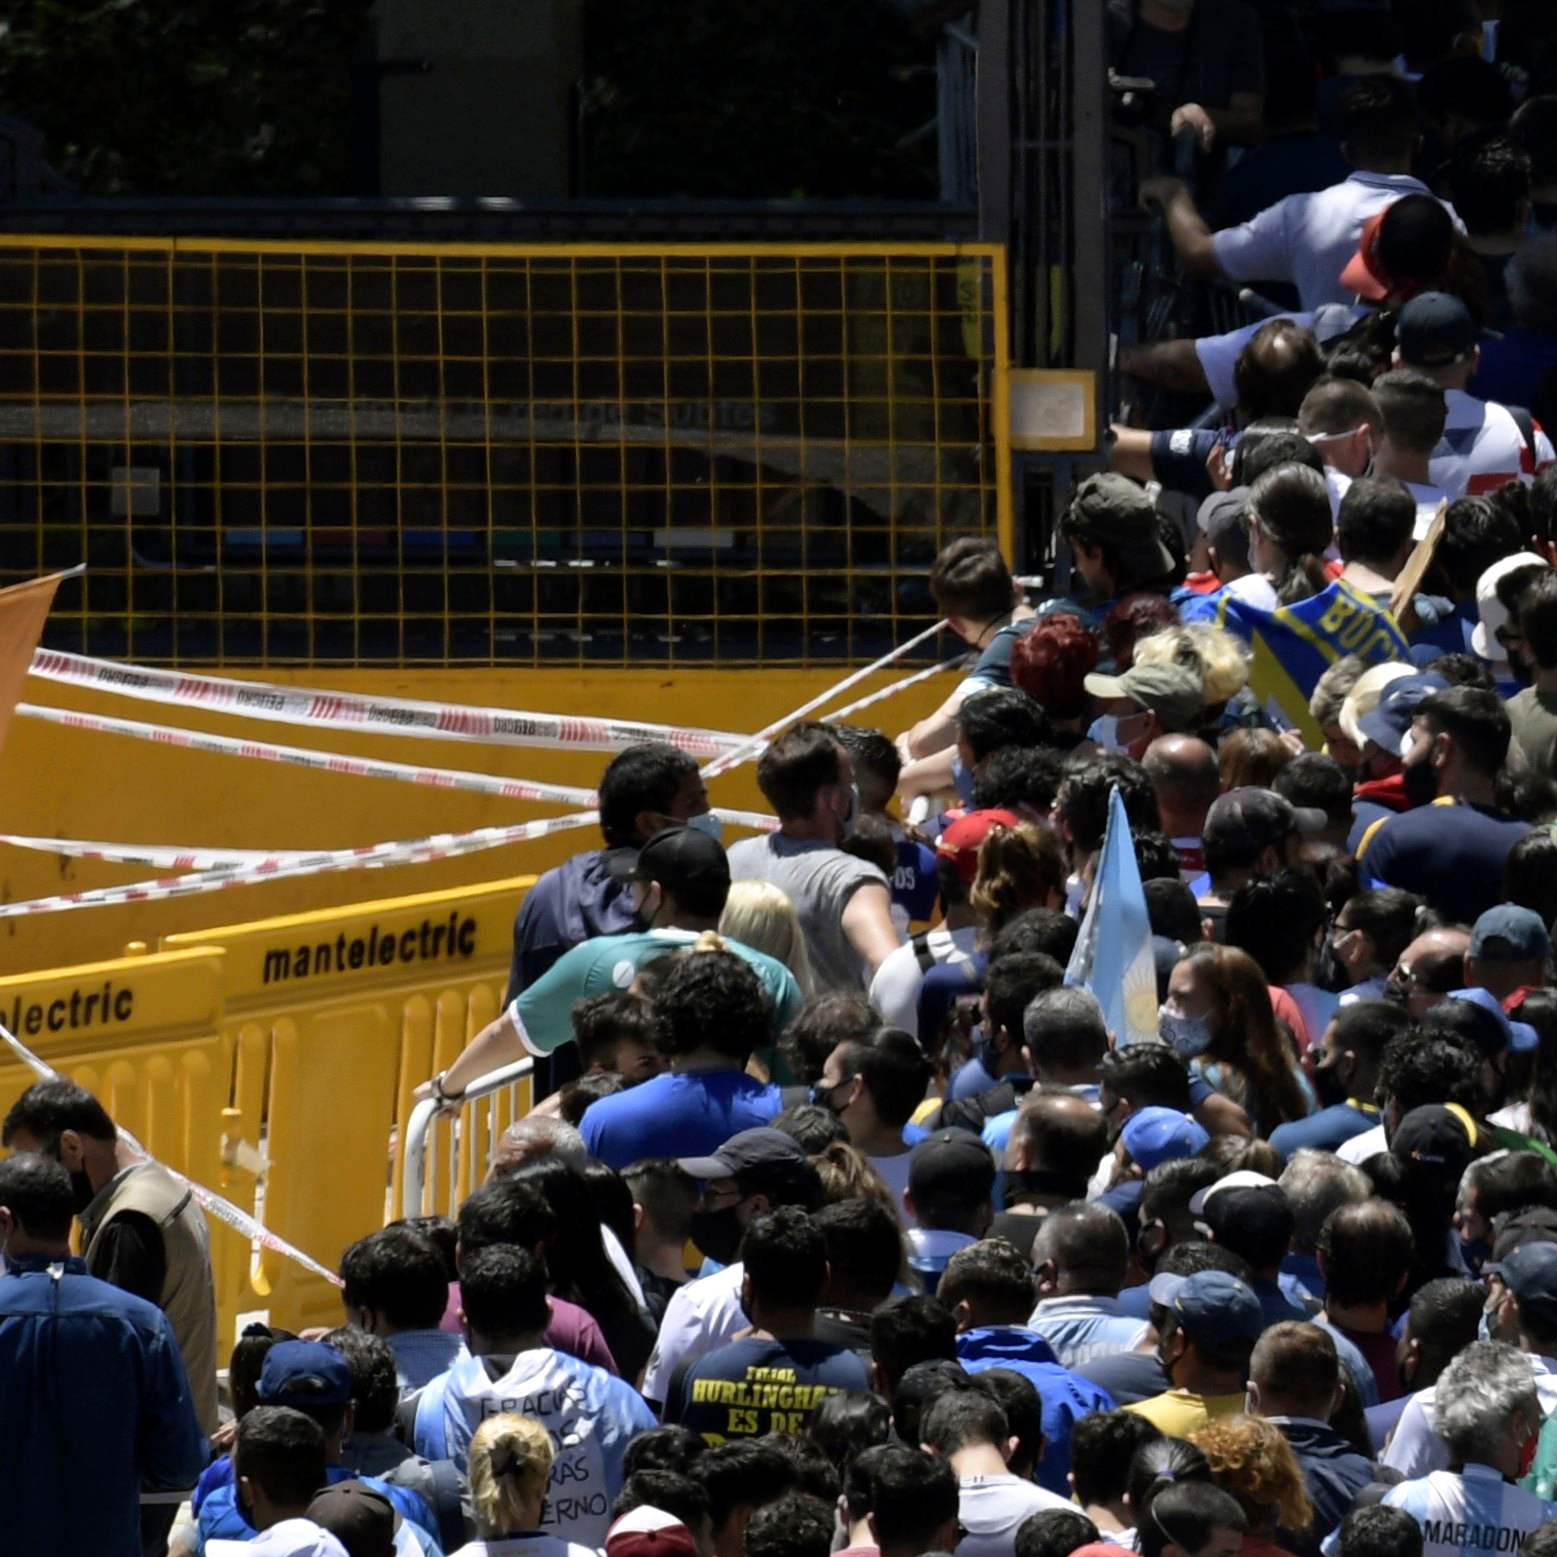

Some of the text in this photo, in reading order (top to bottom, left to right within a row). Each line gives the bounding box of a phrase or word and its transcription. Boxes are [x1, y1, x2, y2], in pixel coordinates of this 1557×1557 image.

[263, 912, 479, 984] mantelectric
[0, 982, 134, 1037] lectric
[693, 1379, 842, 1412] HURLINGHA
[728, 1409, 759, 1434] ES
[539, 1492, 608, 1526] ERNO
[1424, 1519, 1530, 1553] MARADON
